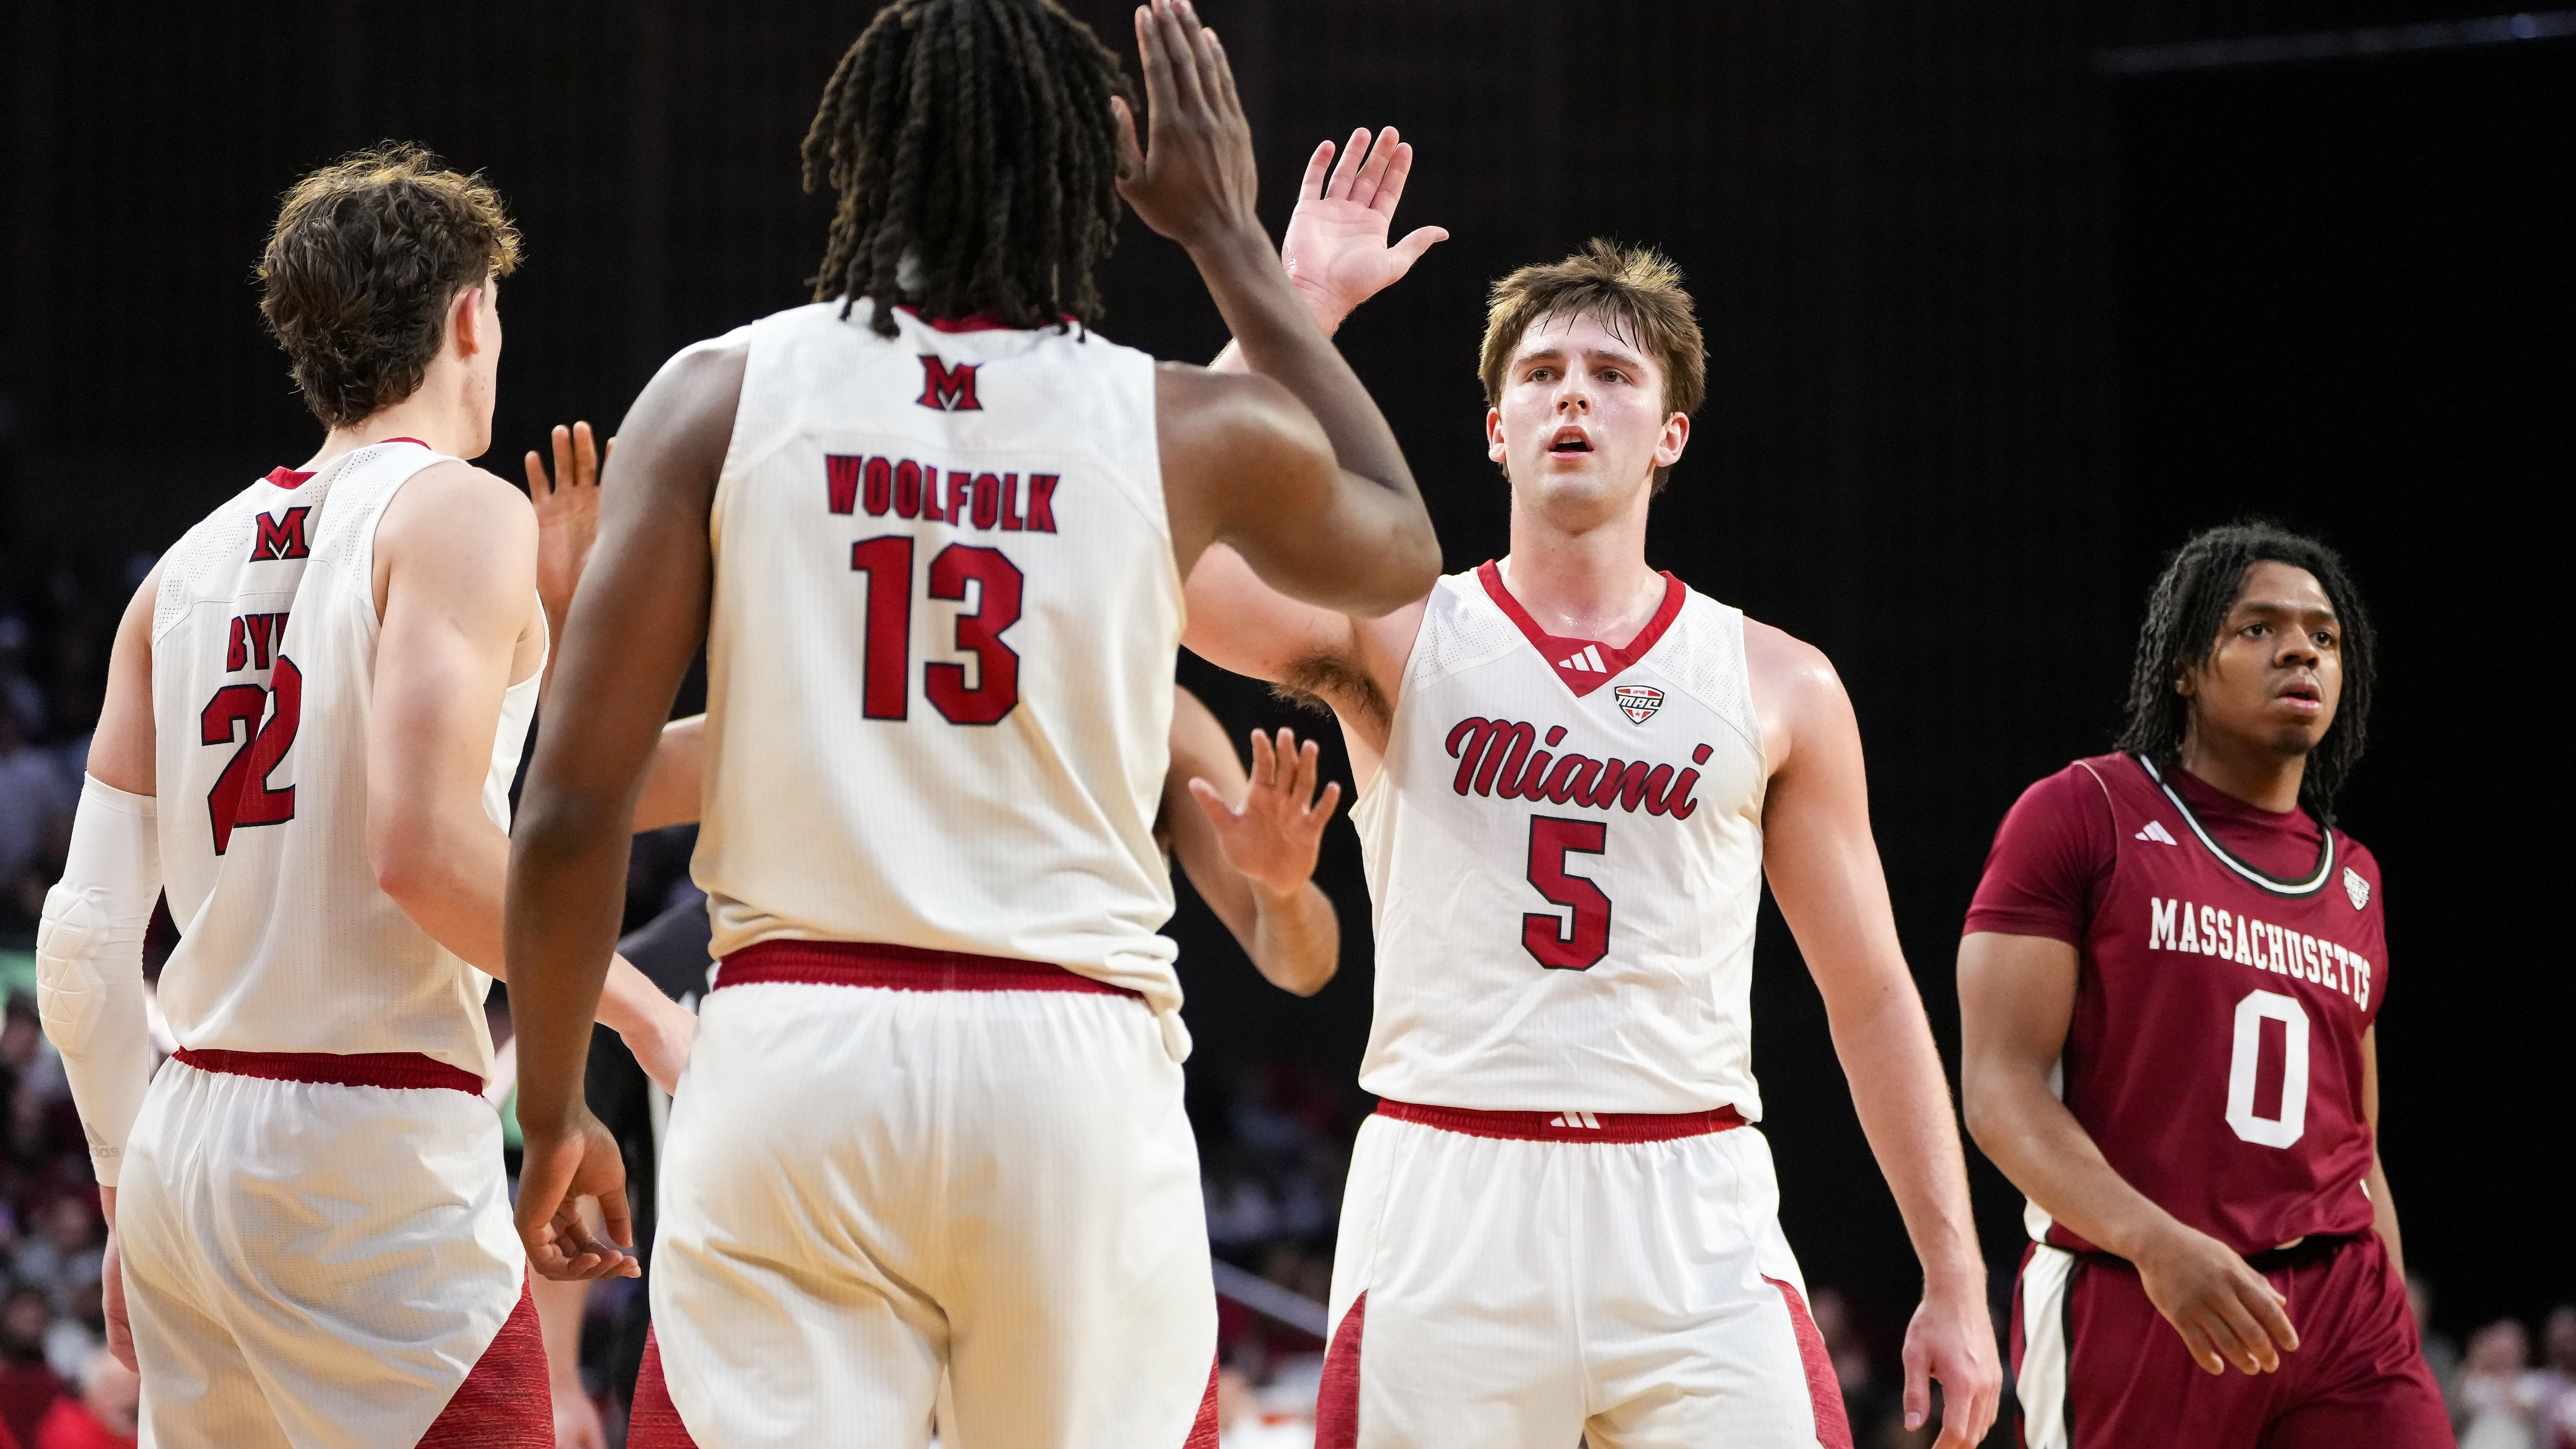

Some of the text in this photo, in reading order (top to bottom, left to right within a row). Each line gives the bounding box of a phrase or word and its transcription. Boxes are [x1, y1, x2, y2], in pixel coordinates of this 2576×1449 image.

[916, 354, 984, 412] M
[249, 506, 312, 562] M
[825, 453, 1060, 534] WOOLFOLK
[227, 612, 290, 673] BY
[851, 534, 1023, 725] 13
[1617, 696, 1660, 709] MAC
[1445, 717, 1714, 820] Miami
[1521, 814, 1612, 971] 5
[2149, 897, 2371, 1012] MASSACHUSETTS
[2225, 989, 2310, 1149] 0
